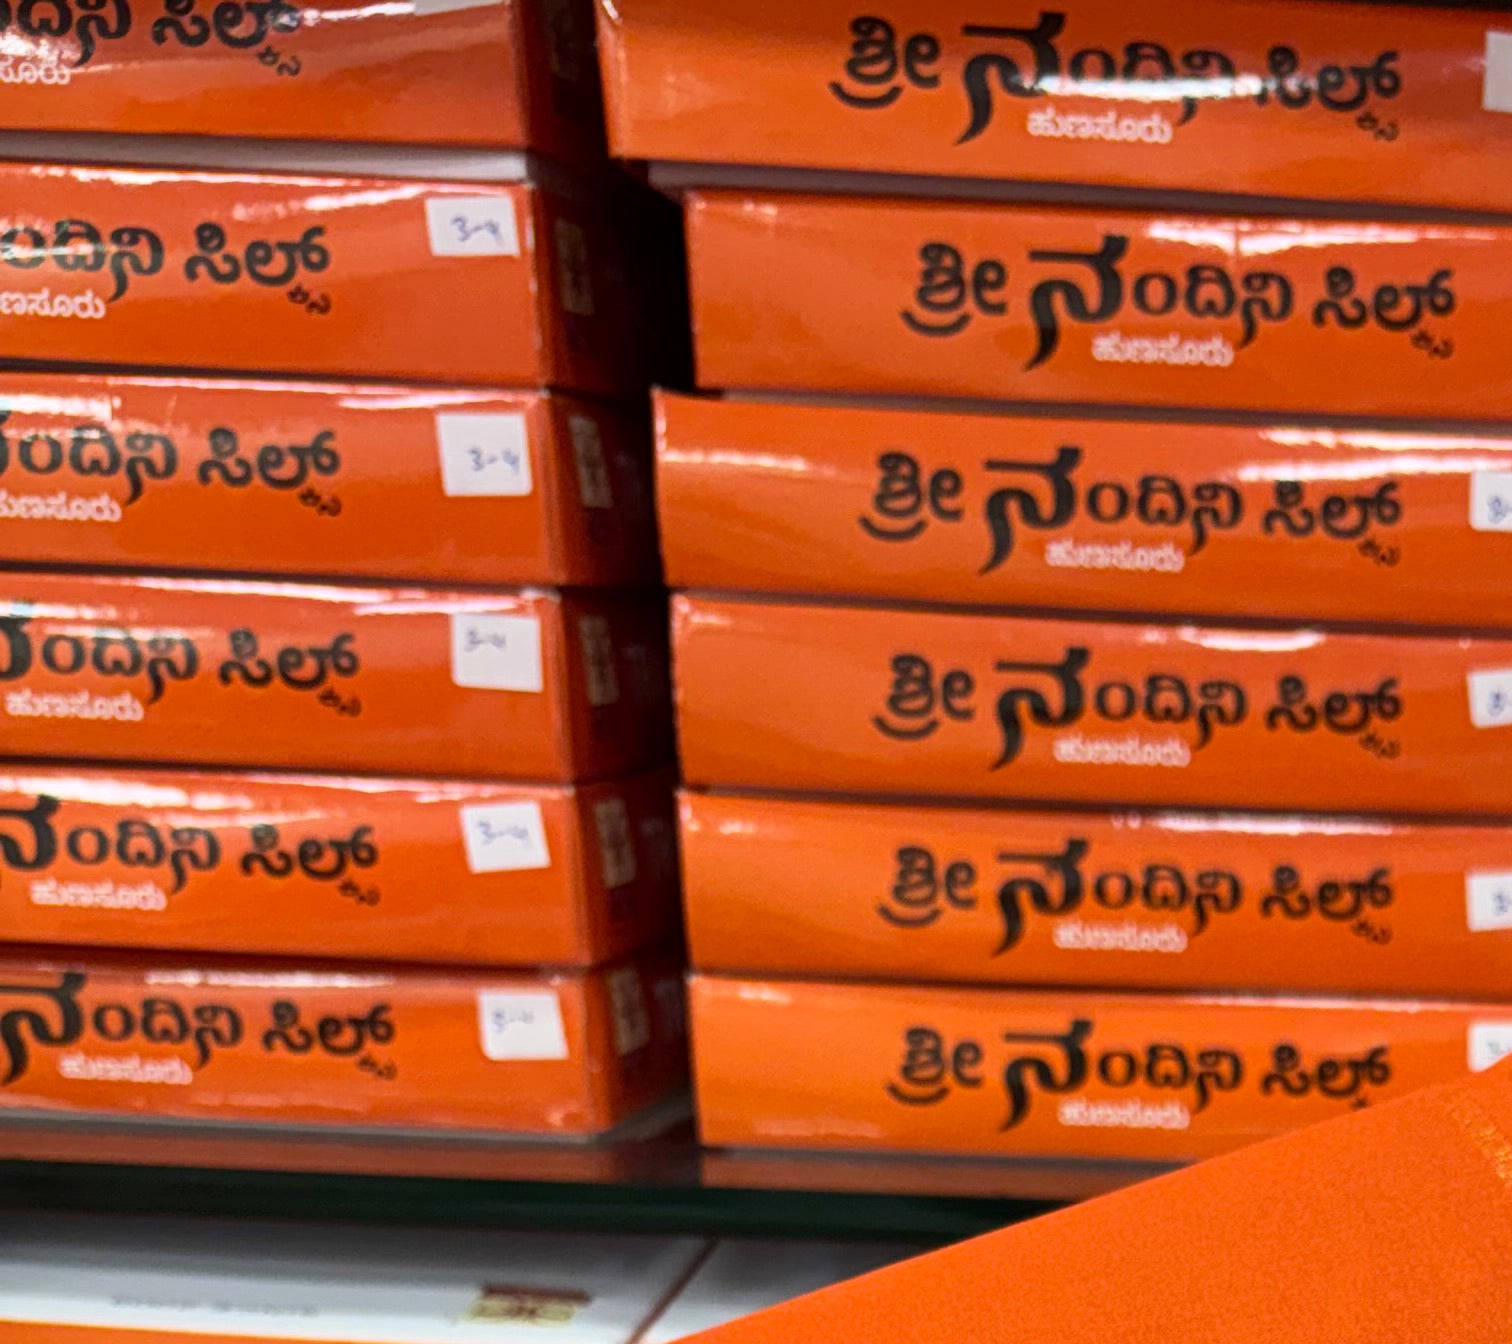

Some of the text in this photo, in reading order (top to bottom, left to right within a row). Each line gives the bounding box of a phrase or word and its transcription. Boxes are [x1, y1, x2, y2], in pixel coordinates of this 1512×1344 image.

[831, 14, 942, 108] ಶ್ರೀ
[959, 8, 1238, 143] ನಂದಿನಿ
[184, 222, 330, 314] ಸಿಲ್ಕ್ಸ್
[901, 234, 1455, 370] ಶ್ರೀ ನಂದಿನಿ ಸಿಲ್ಕ್ಸ್
[198, 427, 341, 516] ಸಿಲ್ಕ್ಸ್
[859, 446, 1401, 574] ಶ್ರೀ ನಂದಿನಿ ಸಿಲ್ಕ್ಸ್
[218, 629, 360, 716] ಸಿಲ್ಕ್ಸ್
[873, 646, 1402, 770] ಶ್ರೀ ನಂದಿನಿ ಸಿಲ್ಕ್ಸ್
[240, 825, 378, 905] ಸಿಲ್ಕ್ಸ್
[878, 837, 1393, 955] ಶ್ರೀ ನಂದಿನಿ ಸಿಲ್ಕ್ಸ್
[262, 1000, 395, 1077] ಸಿಲ್ಕ್ಸ್
[887, 1019, 1243, 1132] ಶ್ರೀ ನಂದಿನಿ
